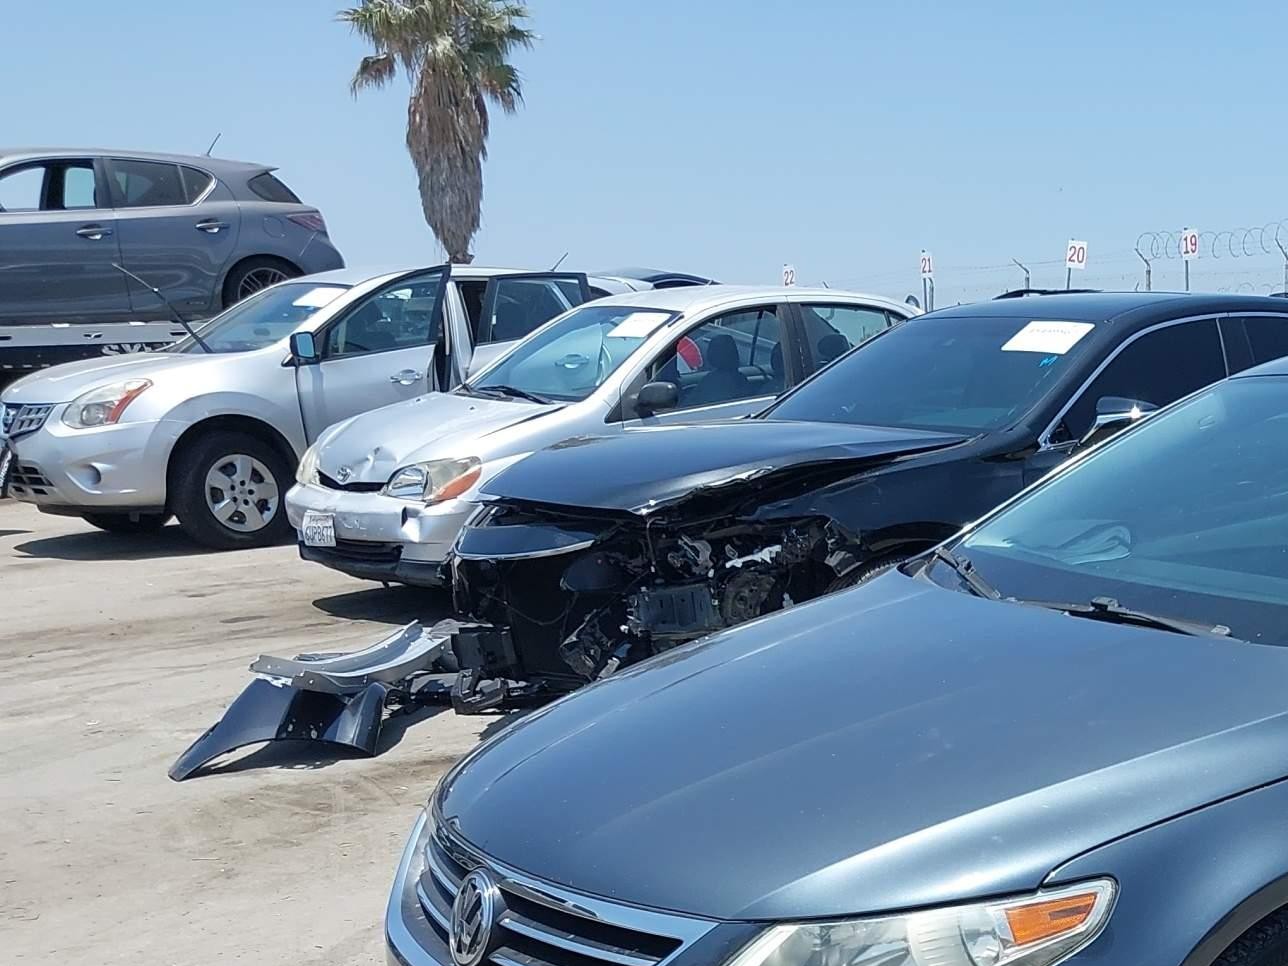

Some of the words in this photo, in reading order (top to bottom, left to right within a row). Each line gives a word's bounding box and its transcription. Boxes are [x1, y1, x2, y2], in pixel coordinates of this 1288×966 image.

[1183, 234, 1197, 254] 19
[1068, 246, 1085, 263] 20
[921, 257, 932, 273] 21
[784, 270, 795, 286] 22
